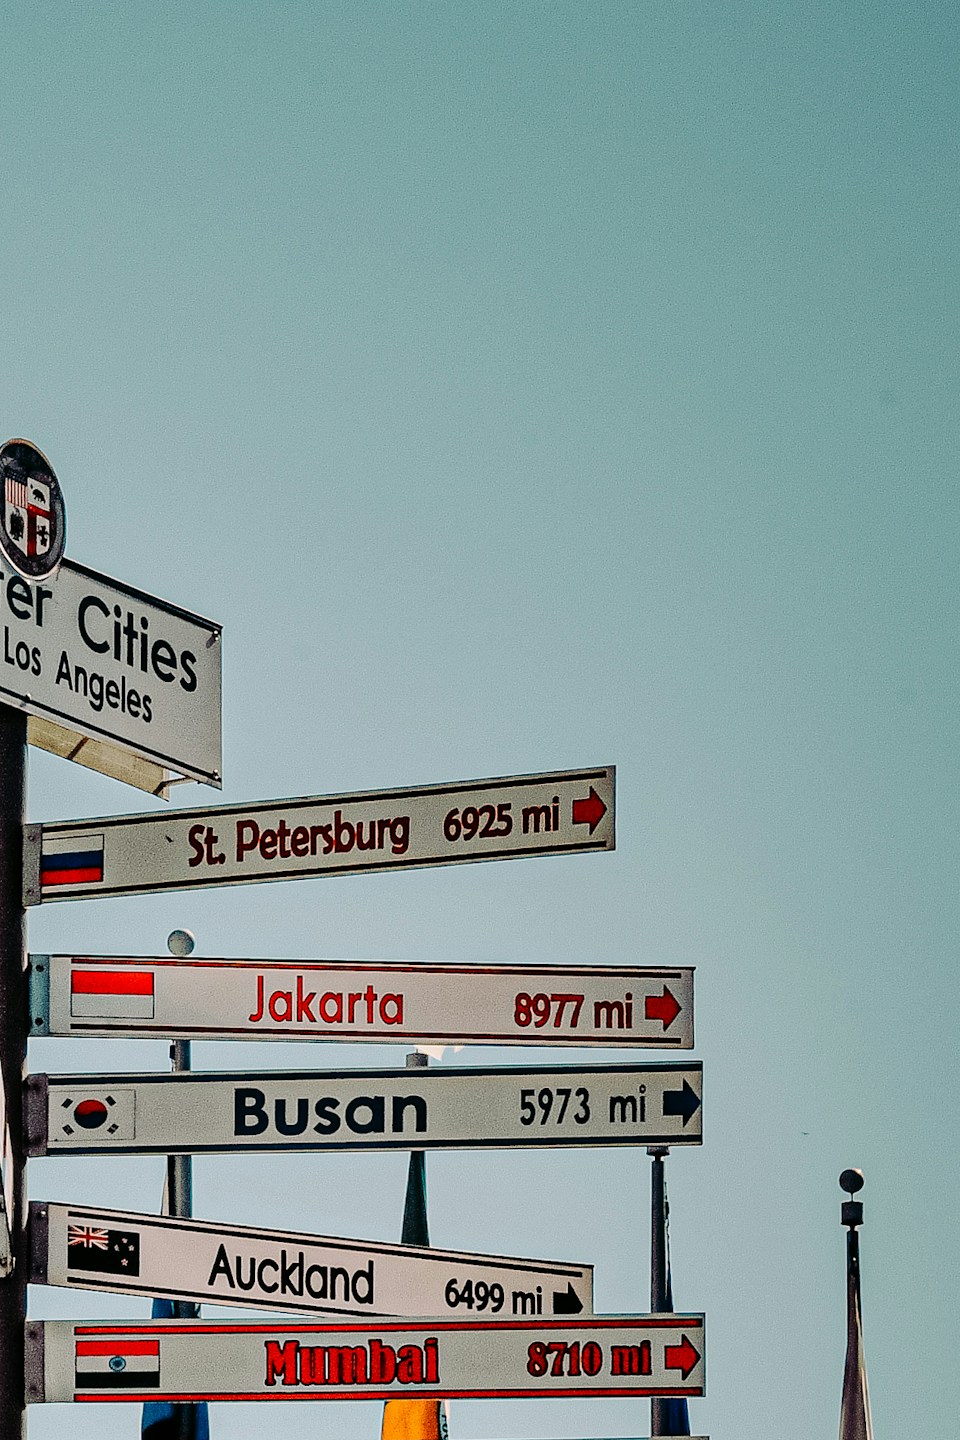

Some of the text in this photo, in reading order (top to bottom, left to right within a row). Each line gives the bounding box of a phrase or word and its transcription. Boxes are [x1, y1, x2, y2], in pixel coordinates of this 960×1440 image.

[4, 626, 41, 676] Los
[56, 650, 153, 723] Angeles
[78, 594, 197, 692] Cities
[188, 796, 560, 867] St. Petersburg 6925 mi
[248, 975, 632, 1030] Jakarta 8977 mi
[234, 1085, 646, 1137] Busan 5973 mi
[208, 1244, 543, 1316] Auckland 6499 mi
[264, 1337, 652, 1387] Mumbai 8710 mi
